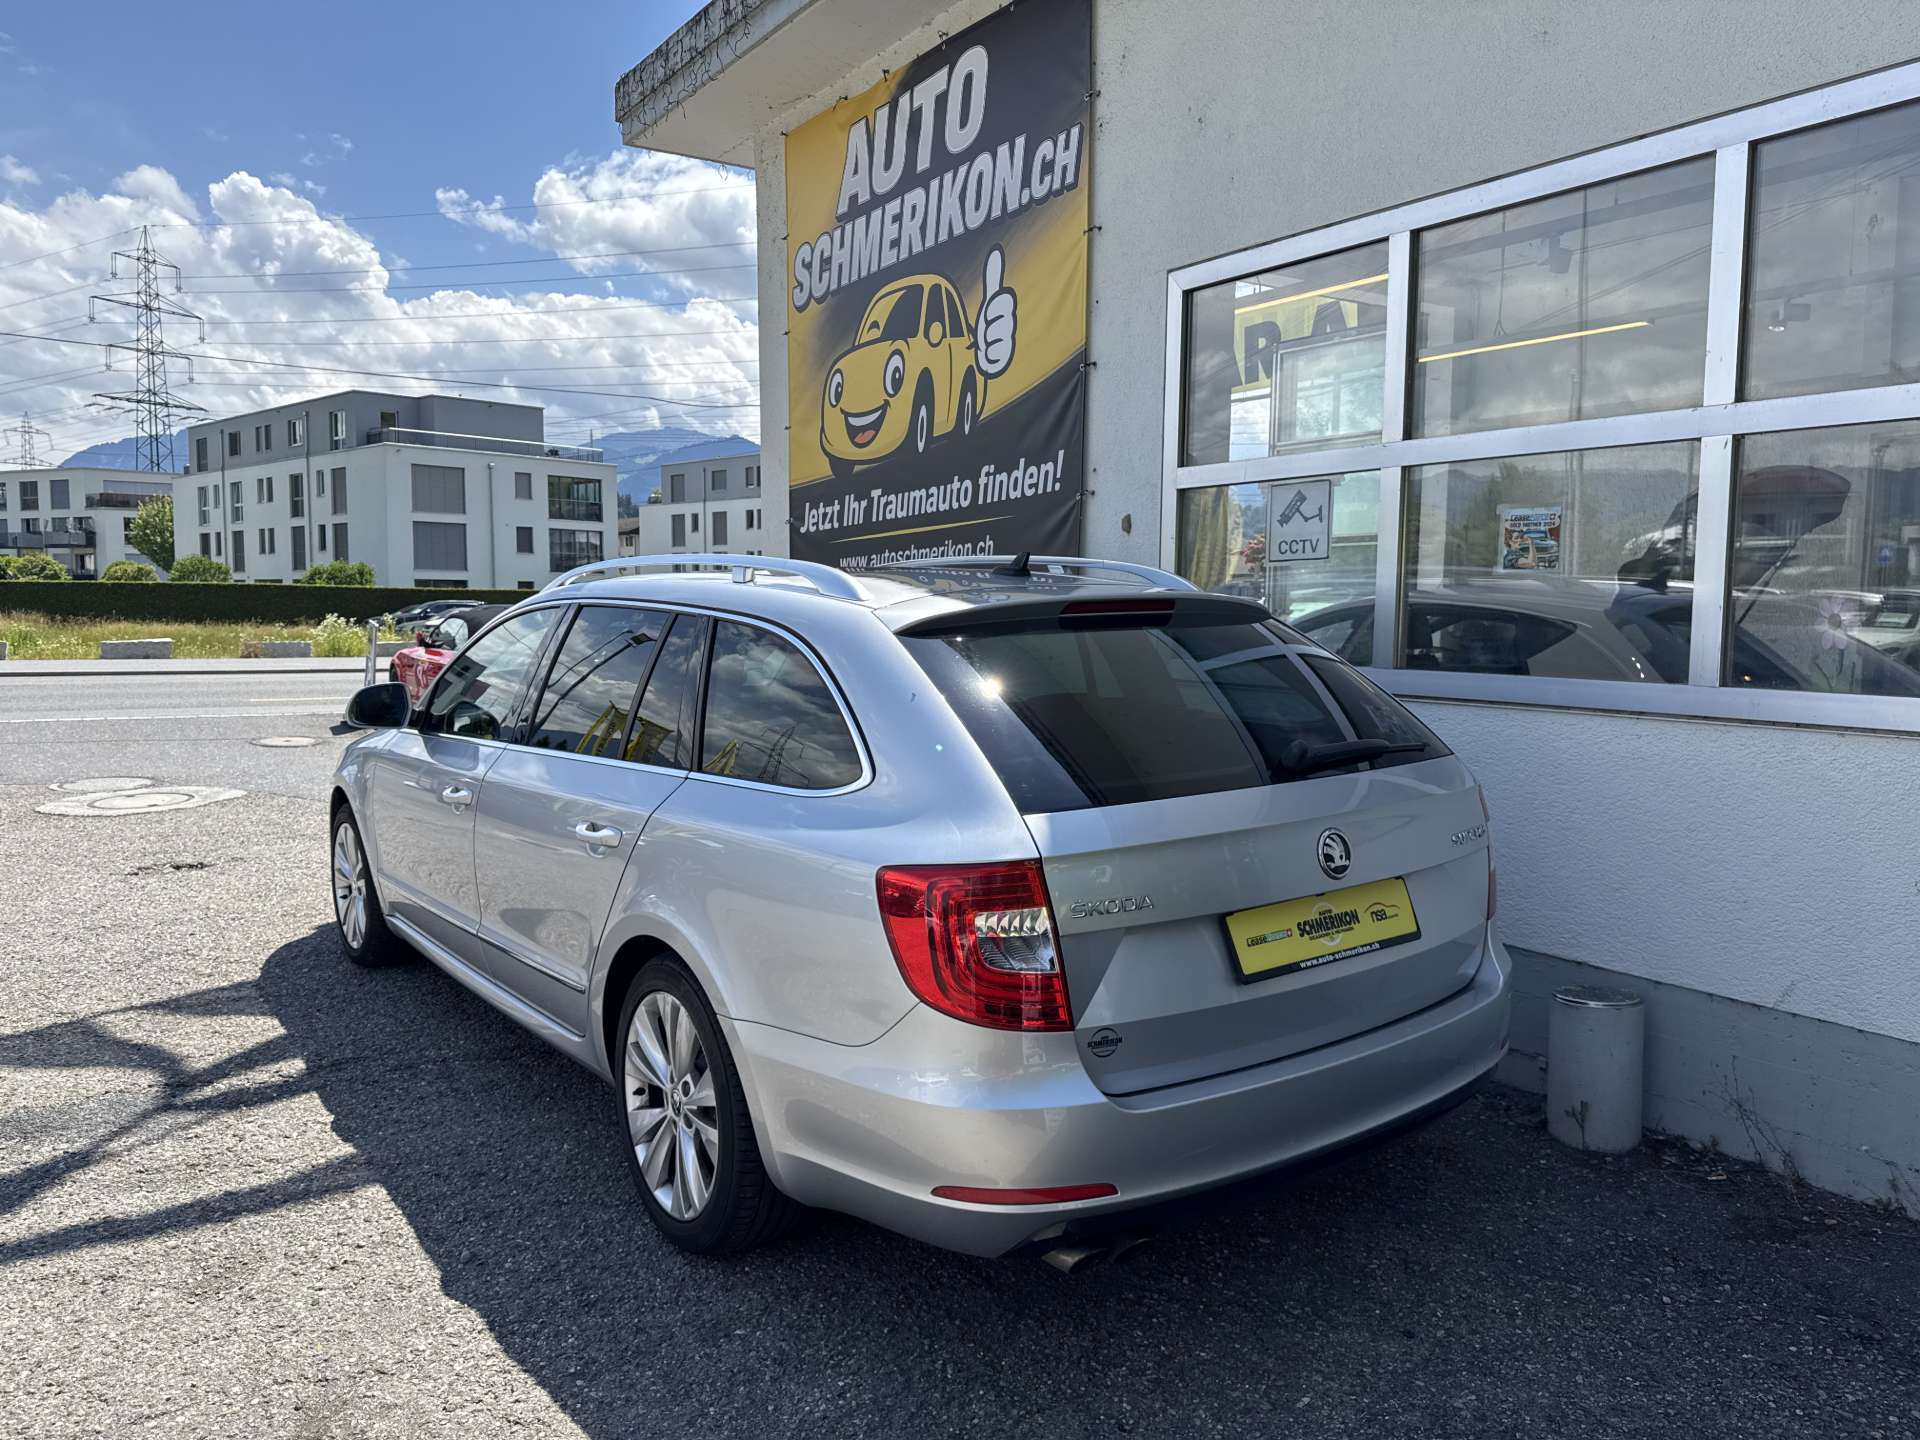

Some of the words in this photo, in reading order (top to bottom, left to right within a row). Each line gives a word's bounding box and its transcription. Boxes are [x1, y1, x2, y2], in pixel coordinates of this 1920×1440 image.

[836, 44, 988, 219] AUTO
[792, 122, 1083, 302] SCHMERIKON.CH
[800, 502, 839, 534] Jetzt
[843, 494, 866, 527] Ihr
[870, 474, 973, 523] Traumauto
[978, 449, 1065, 505] finden!
[1278, 538, 1320, 555] CCTV
[1297, 908, 1361, 938] SCHMERIKON
